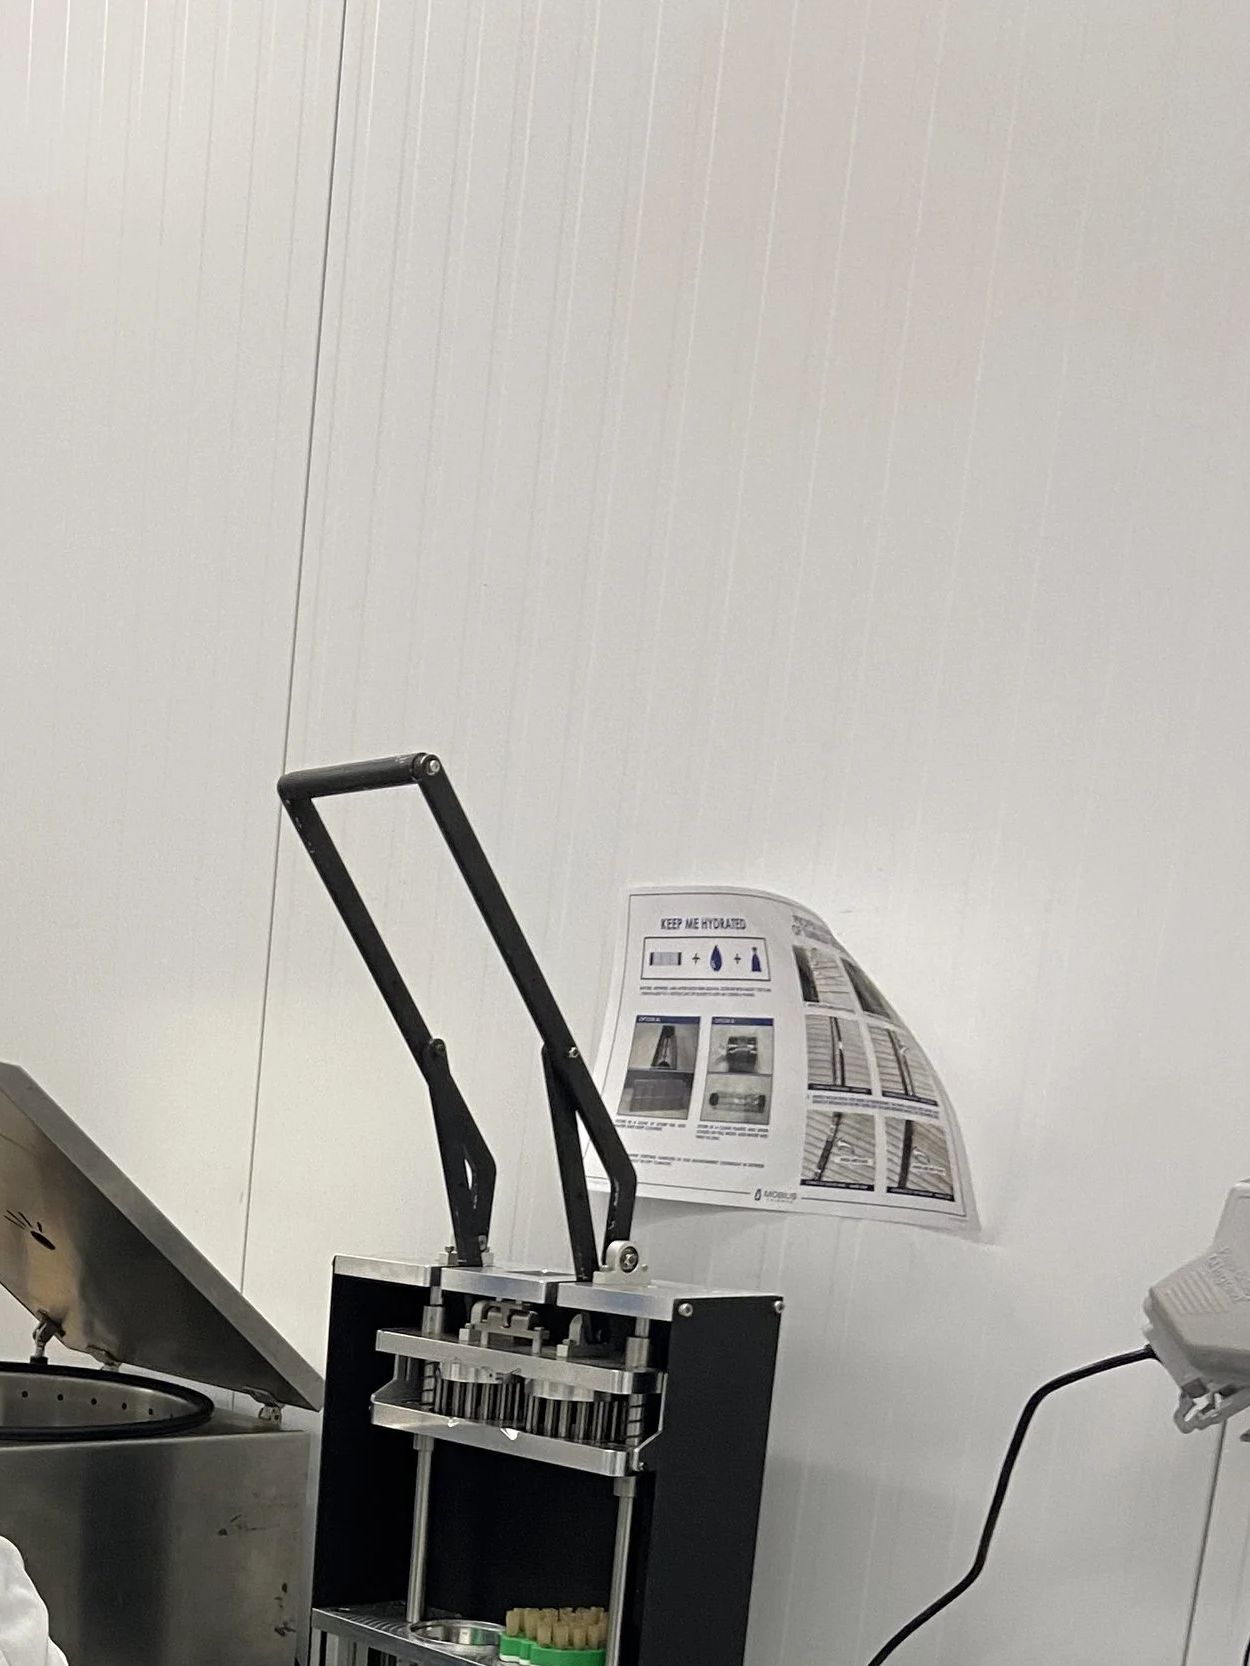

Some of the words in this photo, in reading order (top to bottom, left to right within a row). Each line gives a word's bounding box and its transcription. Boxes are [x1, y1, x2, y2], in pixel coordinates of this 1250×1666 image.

[661, 918, 682, 930] KEEP
[685, 918, 699, 930] ME
[701, 918, 747, 930] HYDRATED
